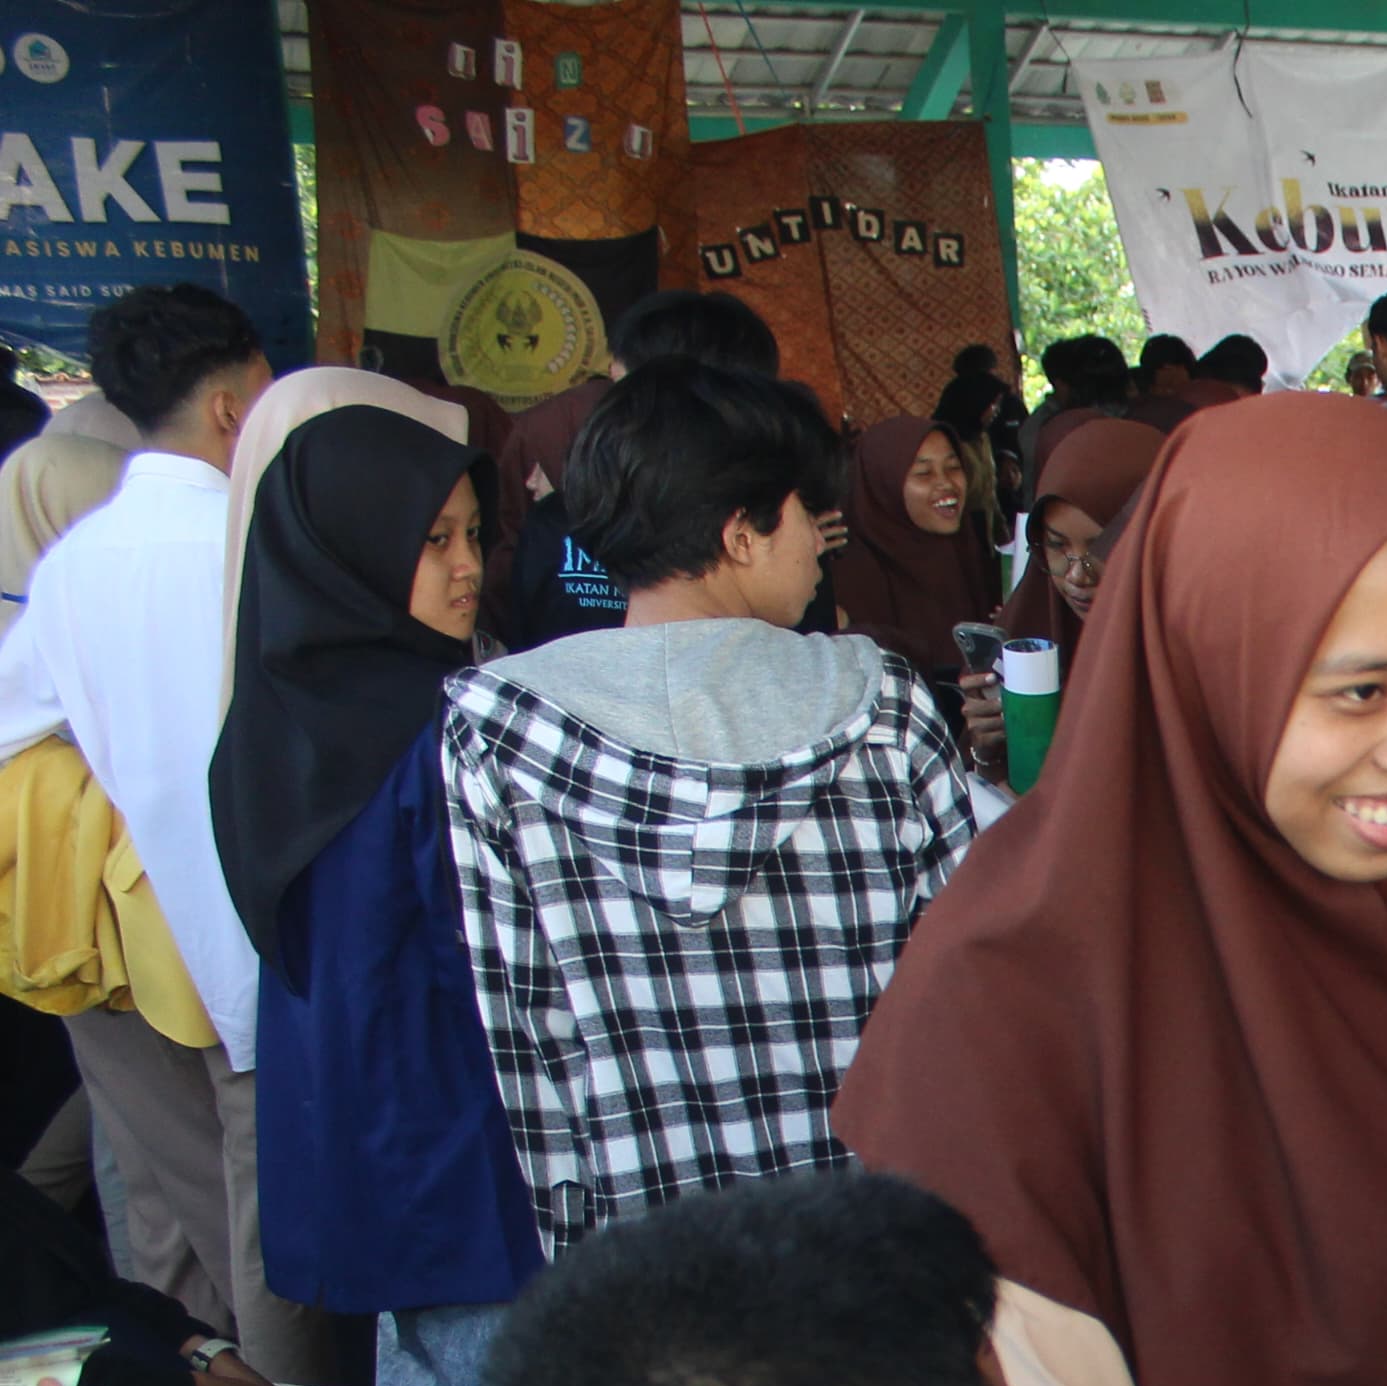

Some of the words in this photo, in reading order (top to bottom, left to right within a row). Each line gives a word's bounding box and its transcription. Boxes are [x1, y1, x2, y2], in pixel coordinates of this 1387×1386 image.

[704, 200, 960, 275] UNTIDAR
[133, 239, 261, 263] KEBUMEN
[1207, 264, 1265, 285] RAYON
[46, 284, 93, 298] SAID
